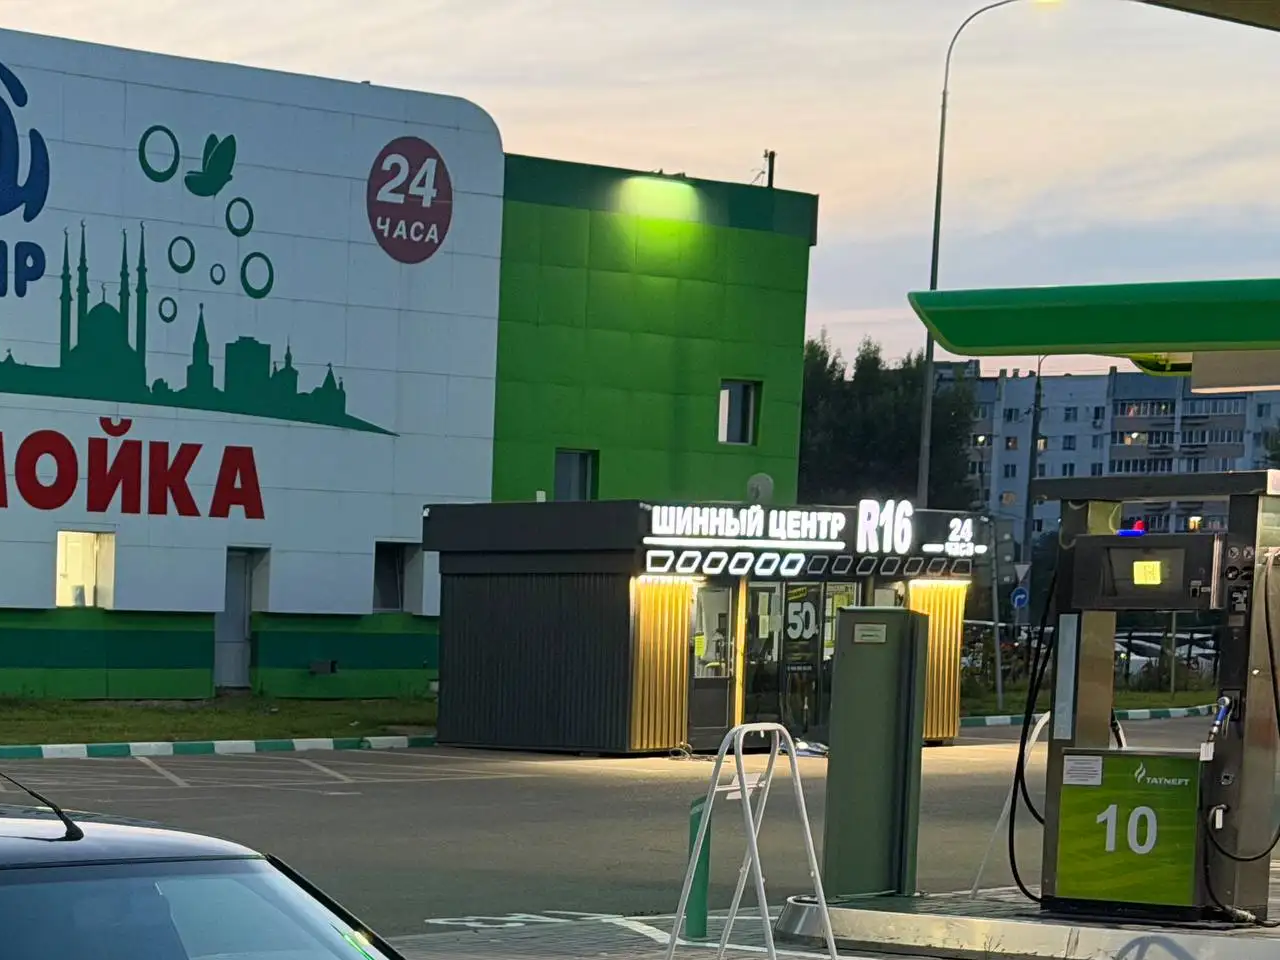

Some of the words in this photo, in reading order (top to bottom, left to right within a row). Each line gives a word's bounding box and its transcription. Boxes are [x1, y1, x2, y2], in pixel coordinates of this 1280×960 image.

[376, 153, 438, 208] 24
[376, 216, 440, 244] ЧАСА
[651, 504, 765, 538] ШИННЫЙ
[768, 509, 846, 540] ЦЕНТР
[856, 499, 914, 554] R16
[948, 517, 973, 542] 24
[1096, 804, 1158, 855] 10
